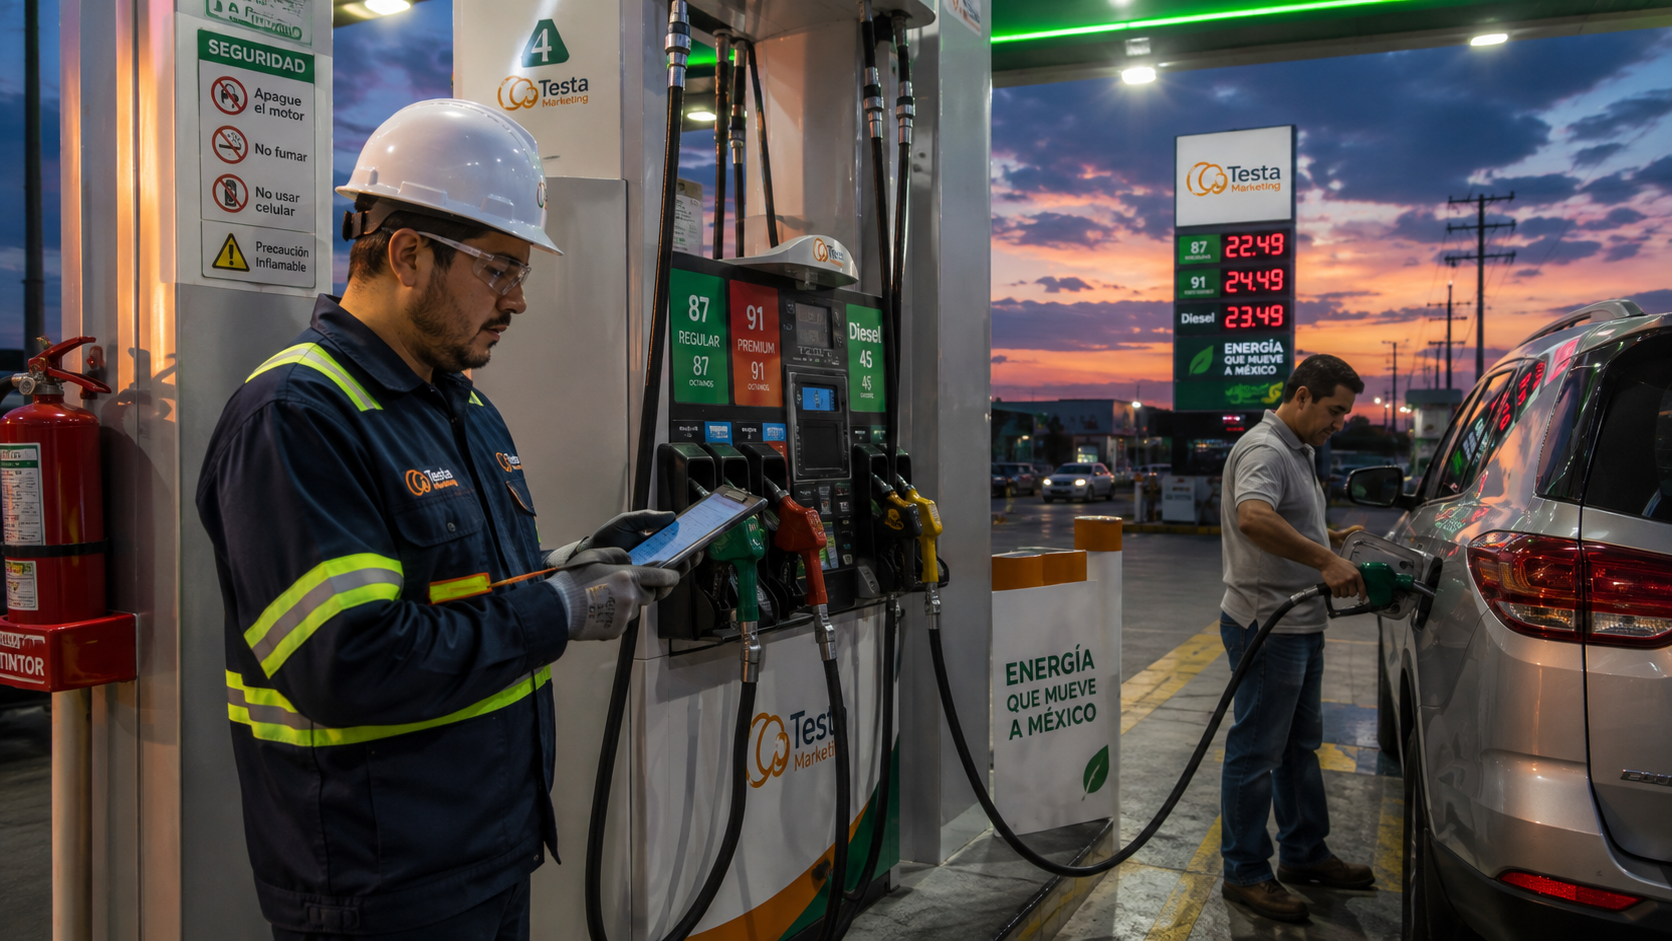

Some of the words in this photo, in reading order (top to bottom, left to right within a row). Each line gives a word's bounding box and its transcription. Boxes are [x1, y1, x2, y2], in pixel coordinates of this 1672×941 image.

[531, 28, 552, 62] 4
[208, 39, 306, 74] SEGURIDAD
[254, 87, 302, 107] Apague
[538, 77, 589, 97] Testa
[542, 95, 589, 108] Marketing
[254, 103, 265, 114] el
[269, 106, 305, 121] motor
[255, 143, 272, 156] No
[274, 146, 308, 162] fumar
[1227, 165, 1281, 183] Testa
[255, 186, 272, 199] No
[275, 191, 300, 203] usar
[1231, 183, 1281, 193] Marketing
[255, 203, 296, 217] celular
[256, 241, 309, 258] Precaución
[1190, 240, 1208, 254] 87
[1225, 233, 1285, 258] 22.49
[1190, 276, 1206, 289] 91
[1225, 268, 1284, 293] 24.49
[688, 294, 710, 323] 87
[746, 304, 764, 331] 91
[1181, 312, 1215, 324] Diesel
[1225, 304, 1284, 328] 23.49
[678, 329, 721, 349] REGULAR
[849, 321, 882, 344] Diesel
[737, 339, 776, 355] PREMIUM
[1224, 338, 1285, 355] ENERGÍA
[693, 355, 709, 376] 87
[1224, 356, 1246, 365] QUE
[1248, 354, 1284, 364] MUEVE
[1224, 366, 1233, 376] A
[1235, 363, 1278, 376] MÉXICO
[751, 361, 764, 381] 91
[1005, 643, 1096, 686] ENERGÍA
[1006, 688, 1041, 714] QUE
[1044, 677, 1097, 705] MUEVE
[790, 705, 846, 749] Test
[1009, 718, 1024, 741] A
[1028, 706, 1097, 736] MÉXICO
